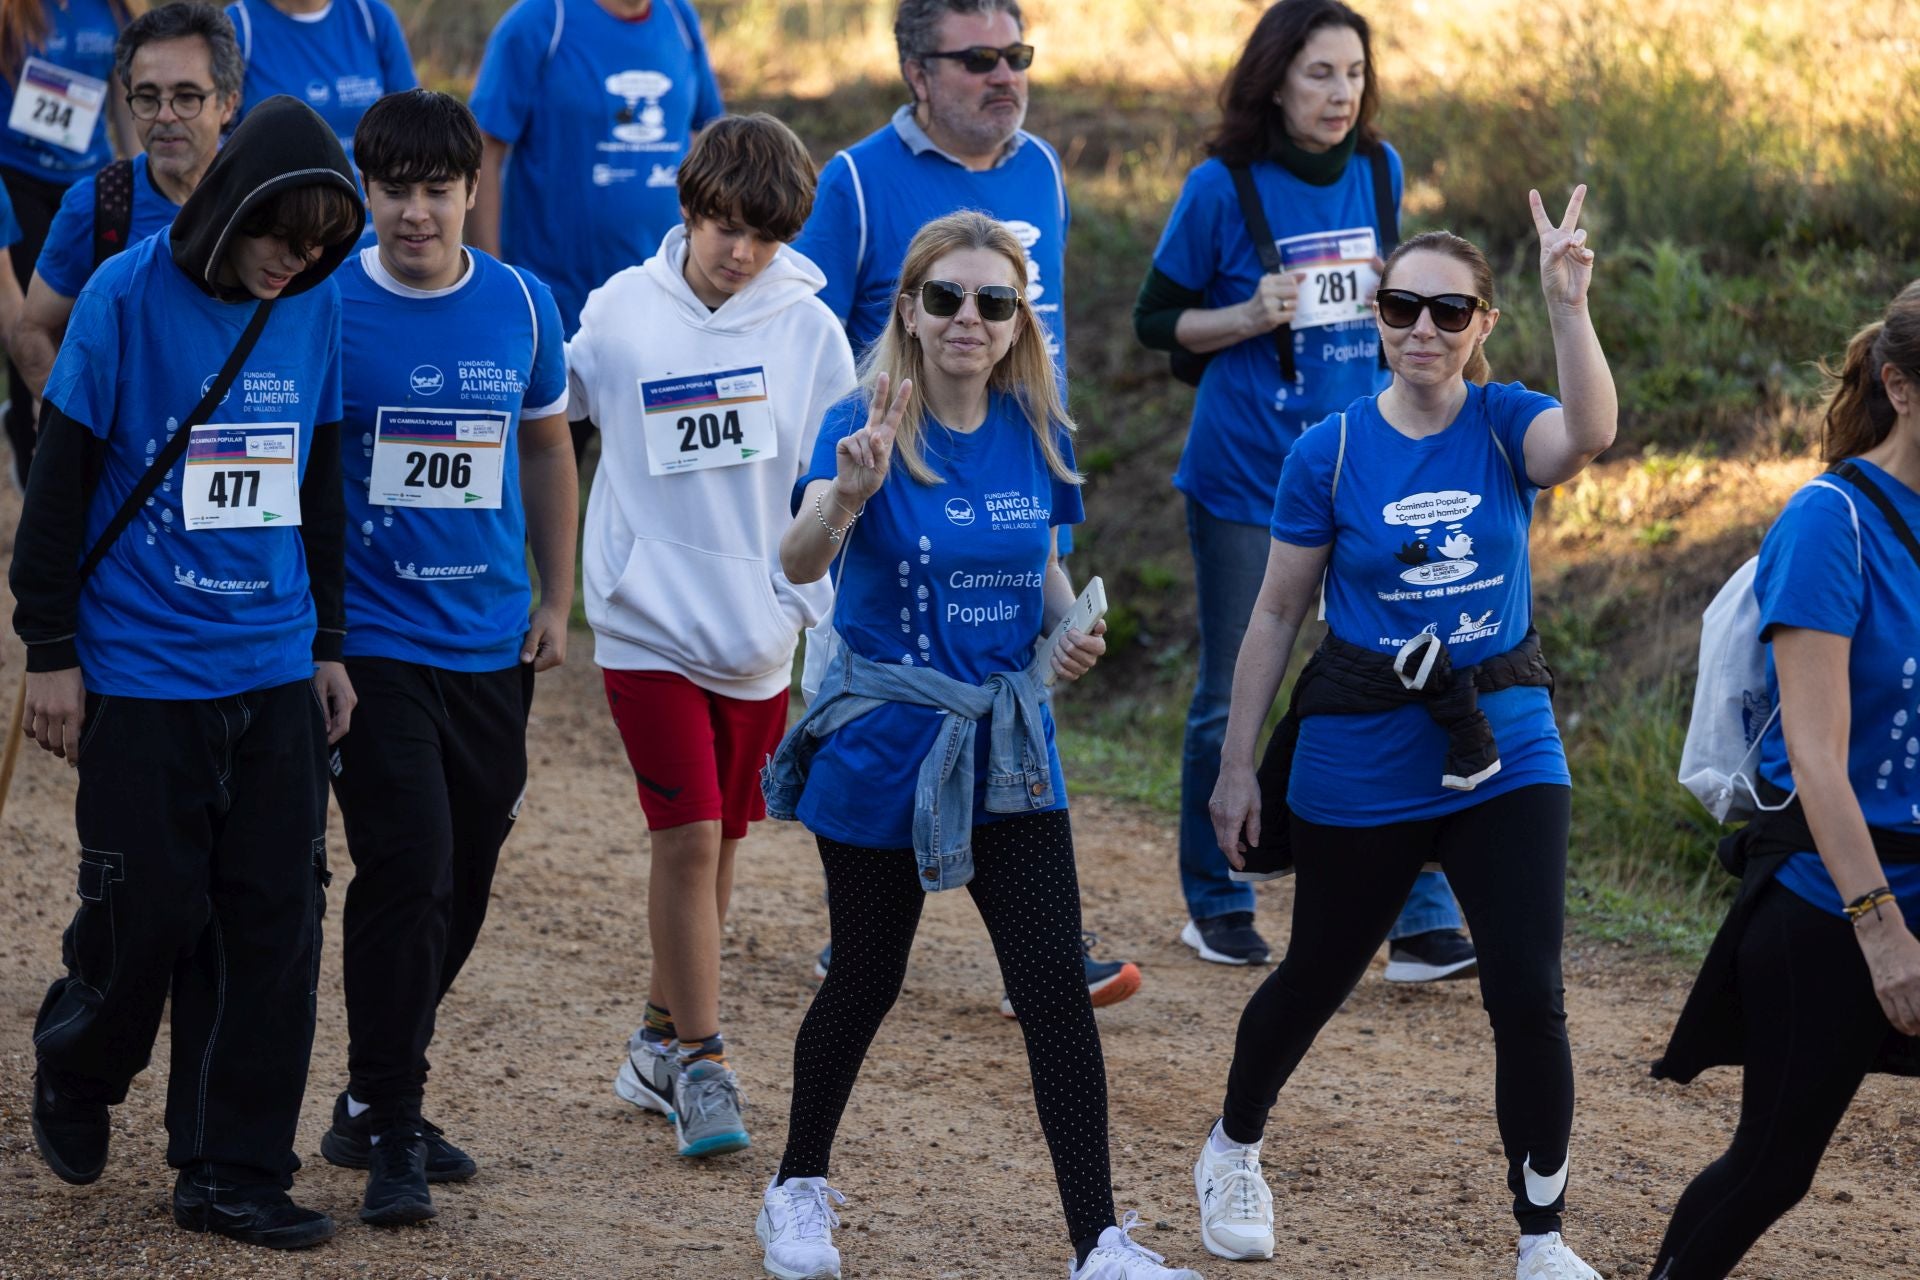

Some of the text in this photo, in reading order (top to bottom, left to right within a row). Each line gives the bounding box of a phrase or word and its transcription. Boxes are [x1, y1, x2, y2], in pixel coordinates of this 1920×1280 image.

[31, 94, 73, 130] 234
[1316, 271, 1357, 305] 281
[459, 367, 517, 381] BANCO DE
[244, 379, 295, 391] BANCO DE
[461, 380, 523, 393] ALIMENTOS
[245, 392, 300, 403] ALIMENTOS
[676, 409, 744, 453] 204
[404, 451, 472, 489] 206
[208, 470, 260, 508] 477
[984, 490, 1020, 500] FUNDACIÓN
[986, 497, 1030, 511] BANCO
[1395, 497, 1467, 511] Caminata Popular
[991, 509, 1050, 522] ALIMENTOS
[420, 563, 489, 576] MICHELIN
[199, 577, 269, 590] MICHELIN
[949, 569, 1042, 589] Caminata
[1424, 588, 1444, 598] CON
[947, 600, 1020, 627] Popular
